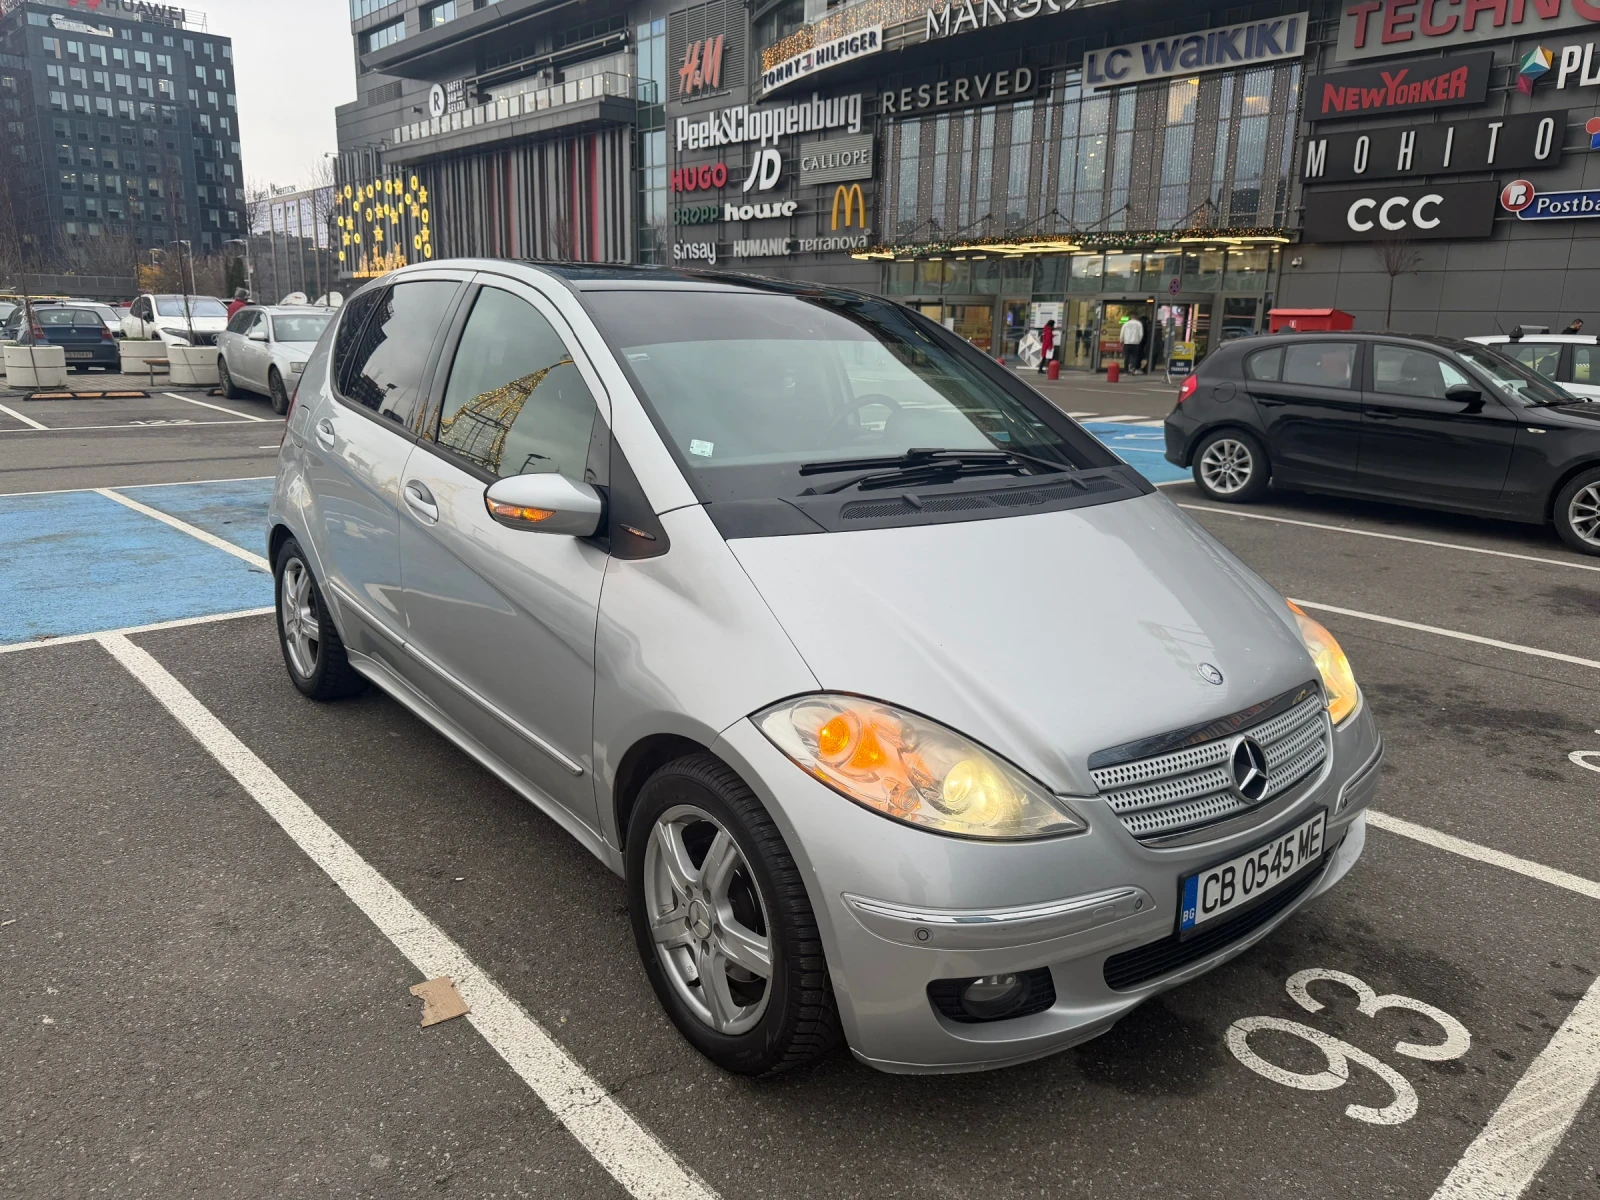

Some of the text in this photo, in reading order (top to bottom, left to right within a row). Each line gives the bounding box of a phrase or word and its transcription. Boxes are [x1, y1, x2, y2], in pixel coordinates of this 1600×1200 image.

[106, 0, 186, 22] HUAWEI
[1346, 0, 1600, 48] TECHN
[678, 34, 723, 95] H&M
[762, 31, 878, 89] TOMMY HILFIGER
[1086, 47, 1132, 84] LC
[1556, 42, 1600, 90] PL
[433, 91, 441, 111] R
[447, 80, 463, 92] RAFFY
[882, 67, 1032, 114] RESERVED
[676, 92, 862, 151] Peek&Cloppenburg
[802, 149, 869, 171] CALLIOPE
[1305, 117, 1555, 178] MOHITO
[670, 162, 727, 193] HUGO
[743, 149, 782, 192] JD
[673, 205, 719, 225] CROPP
[724, 201, 798, 221] house
[1347, 194, 1444, 232] CCC
[673, 239, 717, 265] sinsay
[733, 238, 791, 258] HUMANIC
[1202, 817, 1322, 914] CB 0545 ME
[1182, 907, 1195, 923] BG
[1224, 967, 1473, 1126] 93
